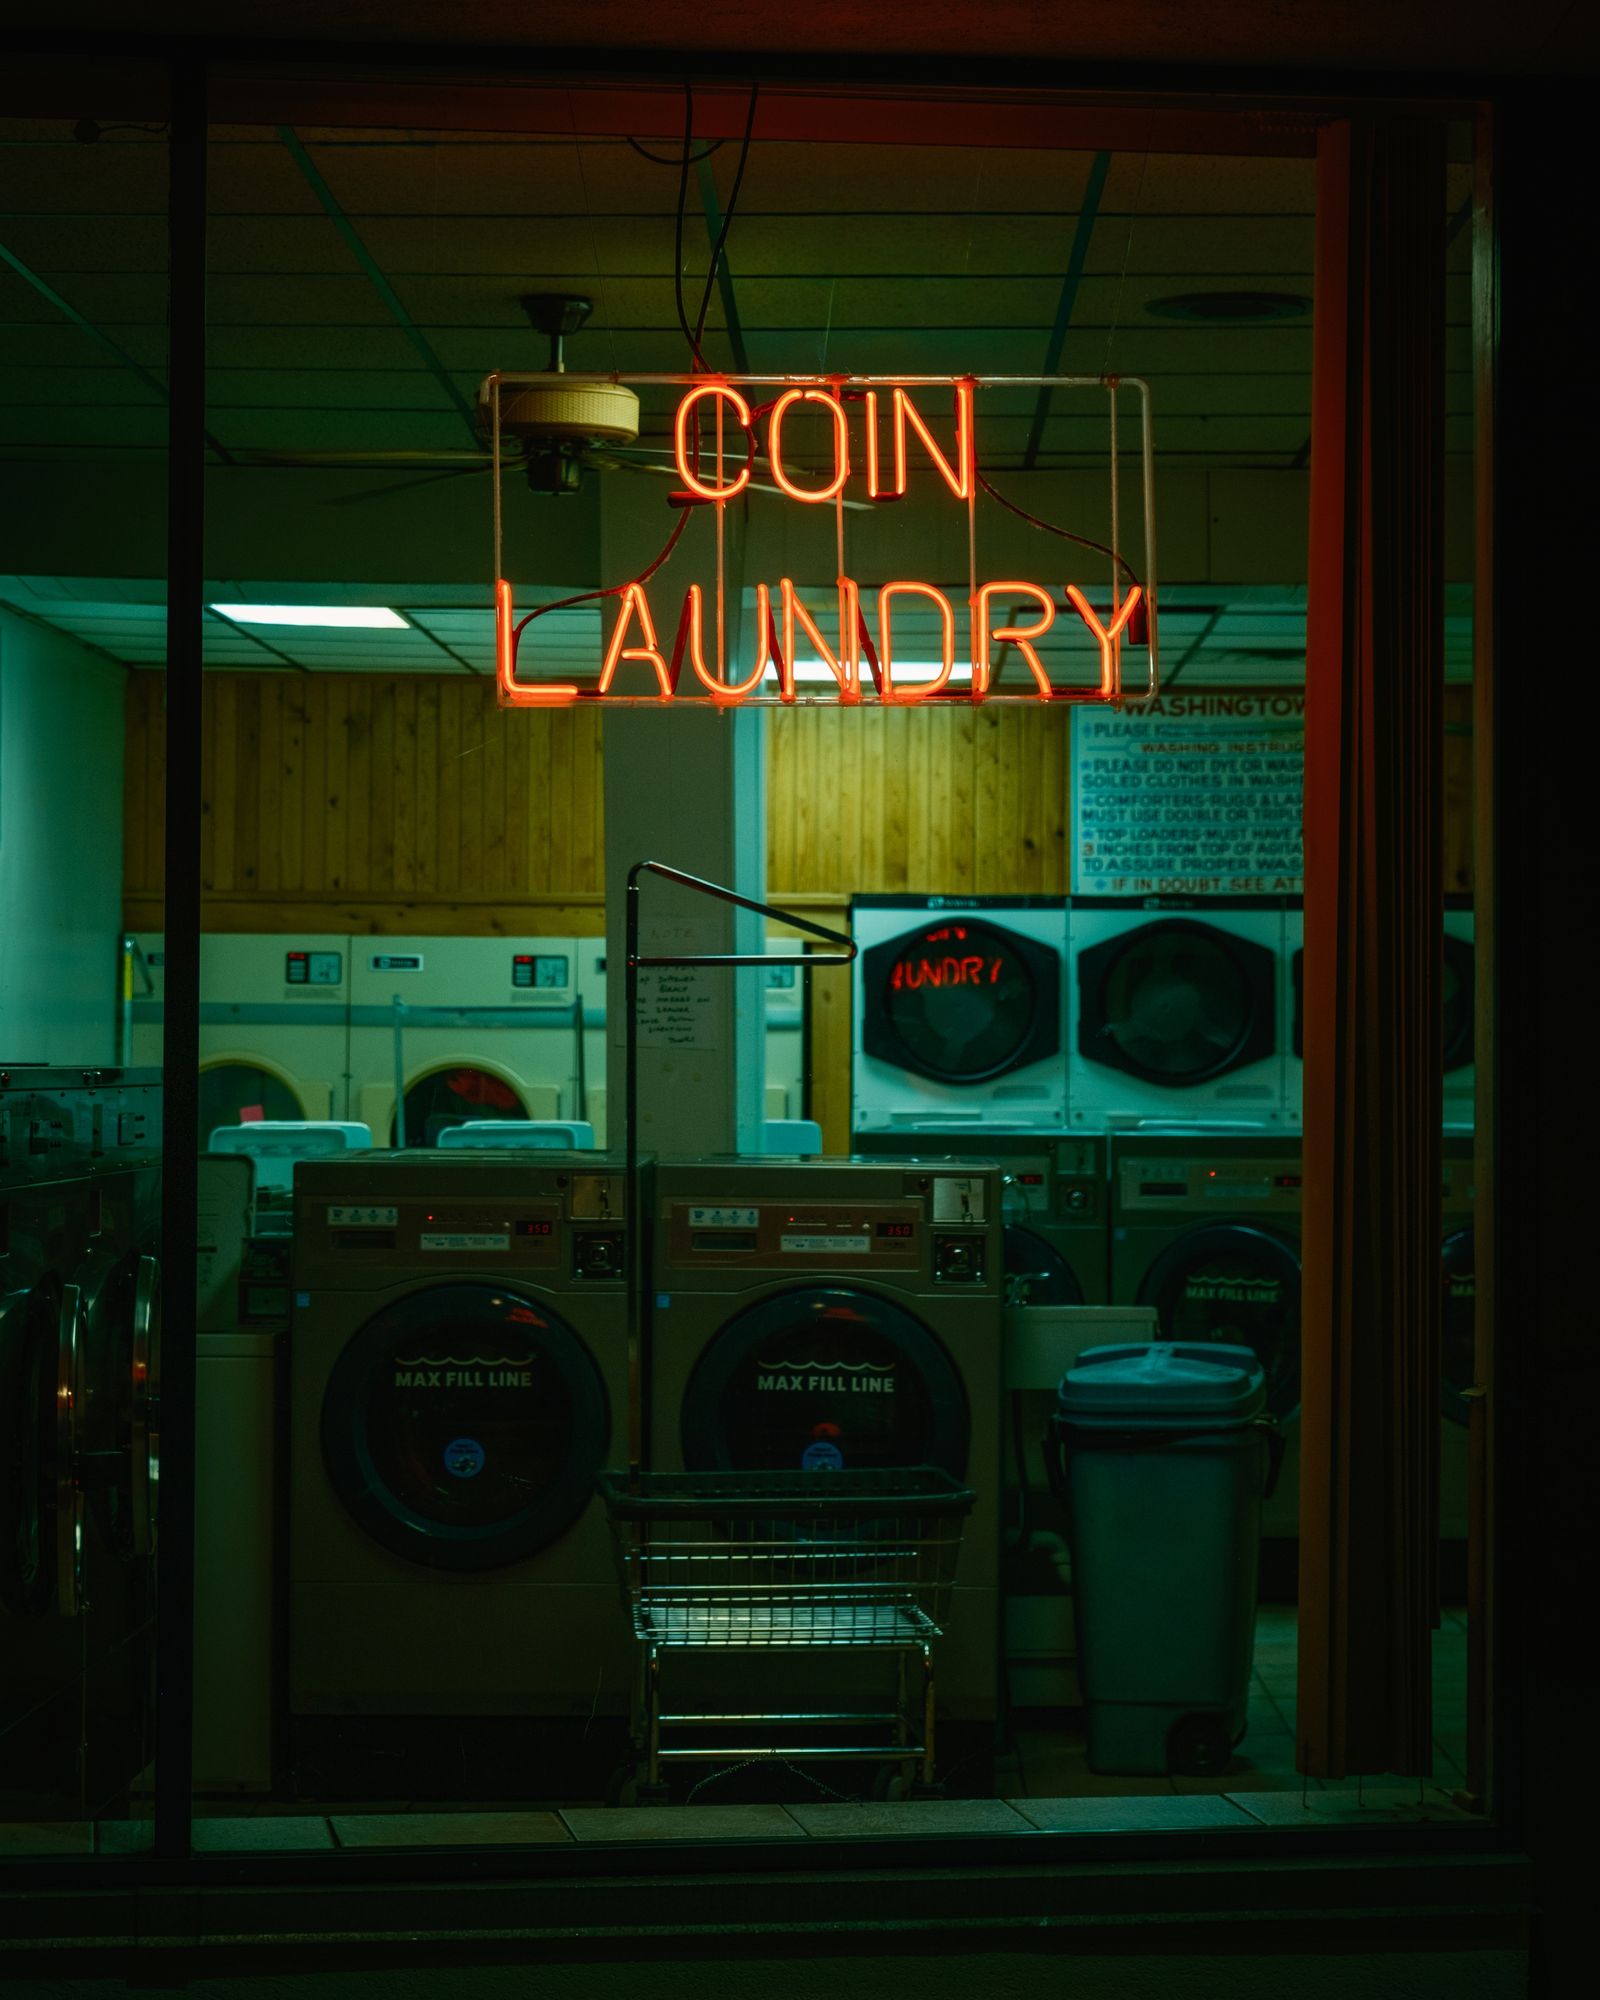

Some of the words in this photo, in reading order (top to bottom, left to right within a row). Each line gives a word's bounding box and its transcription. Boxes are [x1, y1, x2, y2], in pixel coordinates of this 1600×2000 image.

[674, 384, 976, 502] COIN
[495, 578, 1143, 700] LAUNDRY
[1094, 723, 1149, 738] PLEASE
[1141, 743, 1220, 754] WASHING
[1094, 759, 1149, 773] PLEASE
[1153, 759, 1174, 773] DO
[1177, 759, 1206, 773] NOT
[1210, 759, 1238, 773] DYE
[1241, 759, 1262, 773] OR
[1082, 775, 1142, 789] SOILED
[1146, 775, 1222, 788] CLOTHES
[1228, 775, 1244, 787] IN
[1082, 809, 1127, 822] MUST
[1130, 809, 1161, 821] USE
[1165, 809, 1222, 822] DOUBLE
[1225, 809, 1248, 822] OR
[1096, 829, 1127, 841] TOP
[1252, 829, 1291, 841] HAVE
[1083, 843, 1094, 856] 3
[1097, 843, 1154, 856] INCHES
[1157, 843, 1197, 856] FROM
[1200, 843, 1231, 856] TOP
[1233, 843, 1254, 856] OF
[1084, 858, 1104, 872] TO
[1106, 858, 1175, 872] ASSURE
[1181, 858, 1250, 872] PROPER
[1112, 878, 1127, 891] IF
[1134, 878, 1152, 891] IN
[1230, 878, 1266, 892] SEE
[395, 1371, 441, 1388] MAX
[446, 1371, 484, 1388] FILL
[489, 1371, 533, 1388] LINE
[757, 1375, 804, 1391] MAX
[808, 1376, 847, 1392] FILL
[851, 1377, 895, 1393] LINE
